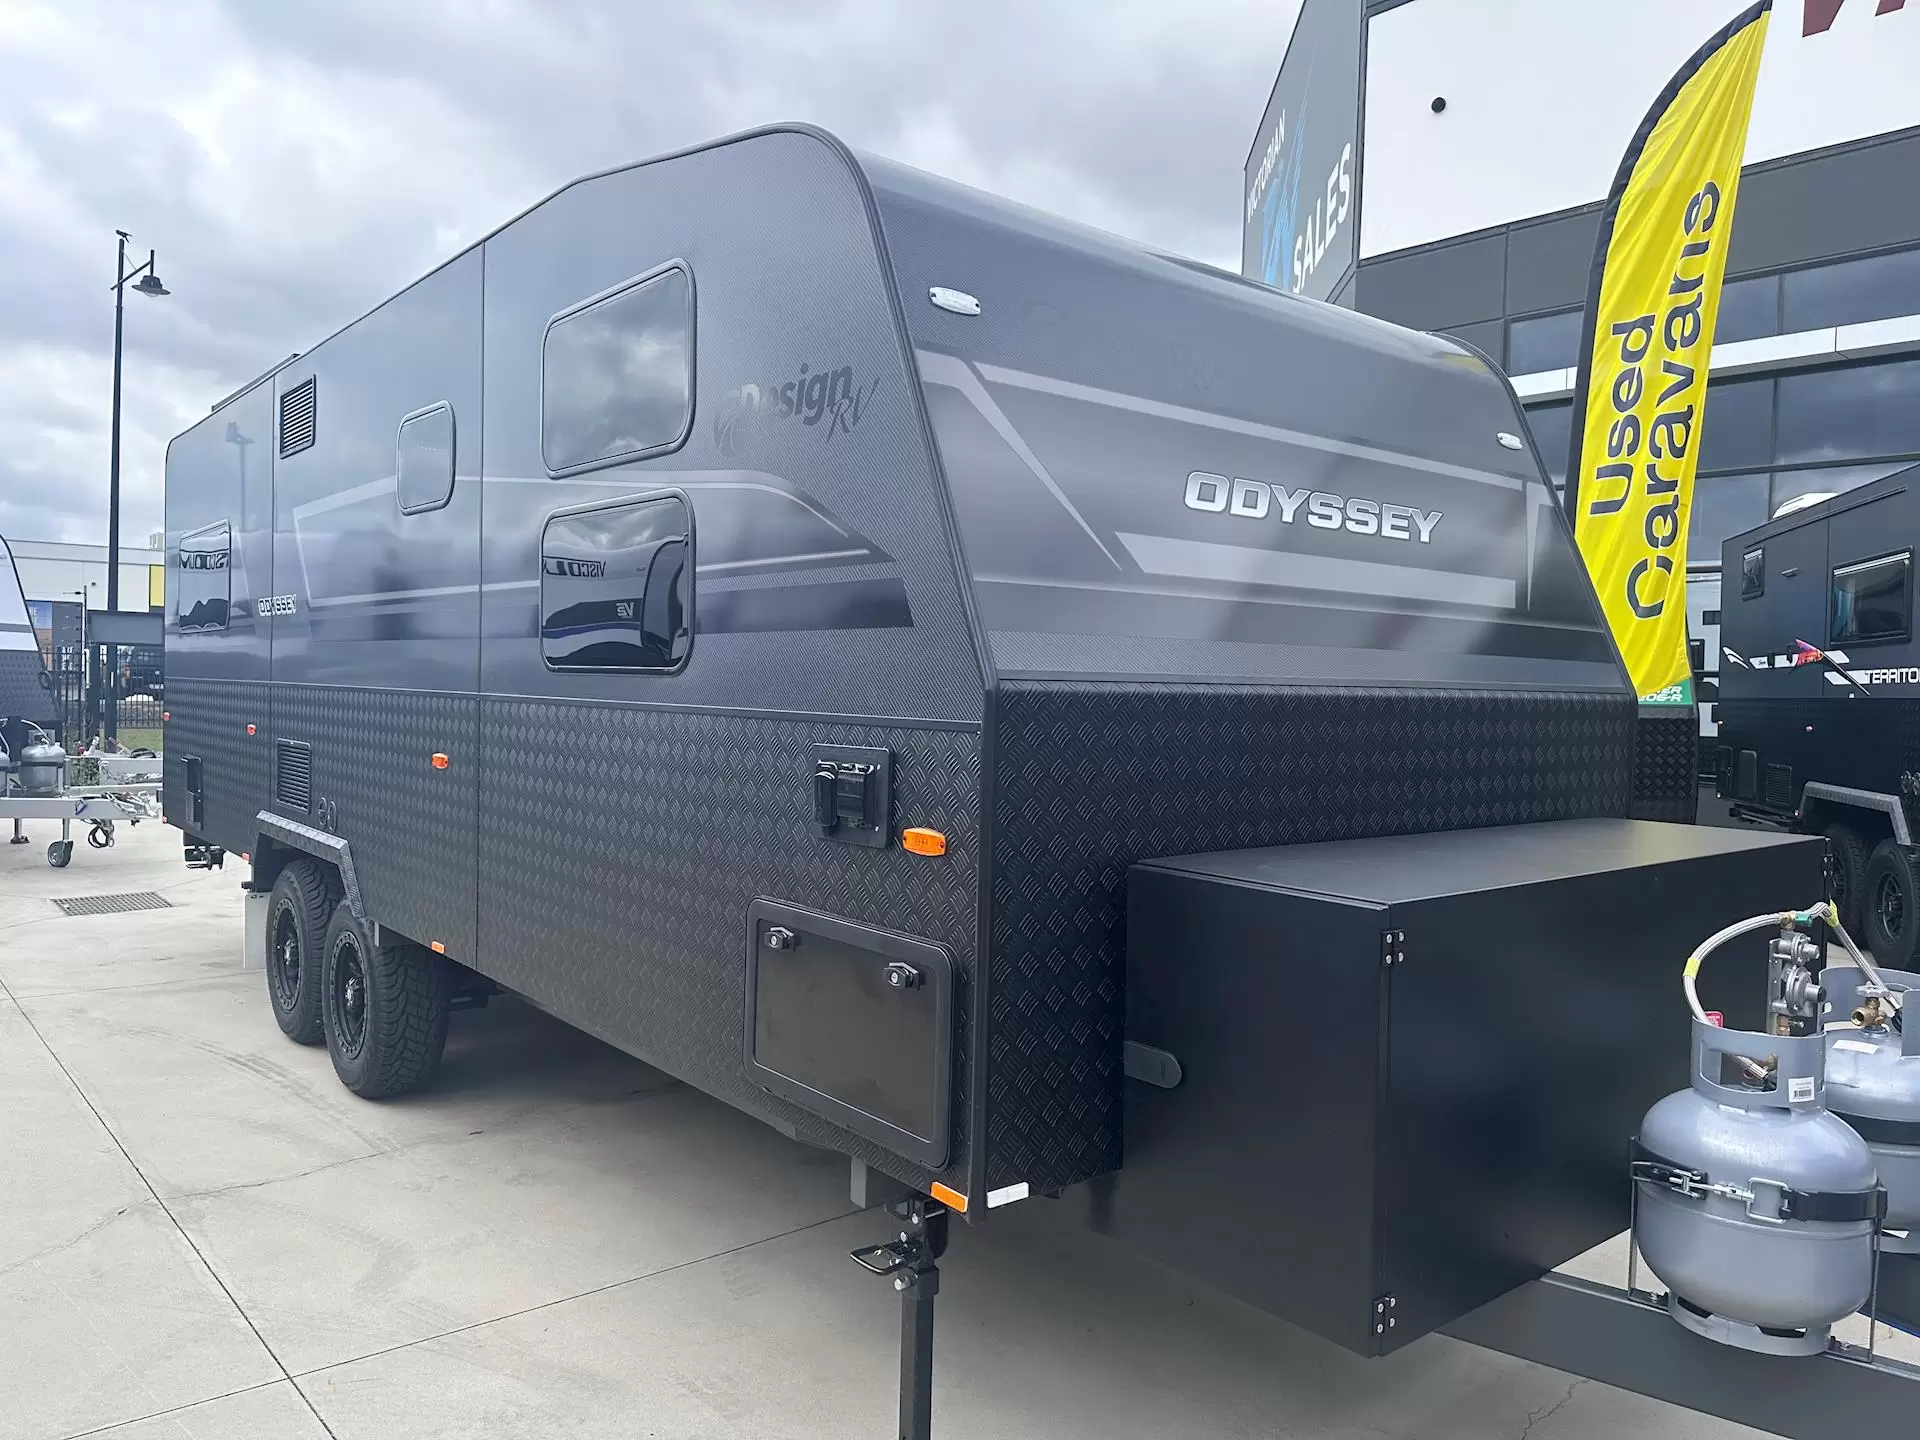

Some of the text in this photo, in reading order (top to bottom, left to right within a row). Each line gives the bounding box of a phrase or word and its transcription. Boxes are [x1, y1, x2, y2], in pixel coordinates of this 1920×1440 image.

[1247, 108, 1286, 224] VICTORIAN
[1293, 142, 1351, 294] SALES
[1589, 313, 1656, 517] Used
[1625, 180, 1721, 620] Caravans
[1184, 471, 1443, 544] ODYSSEY
[258, 594, 297, 616] ODYSSEY
[1865, 667, 1920, 685] TERRITO
